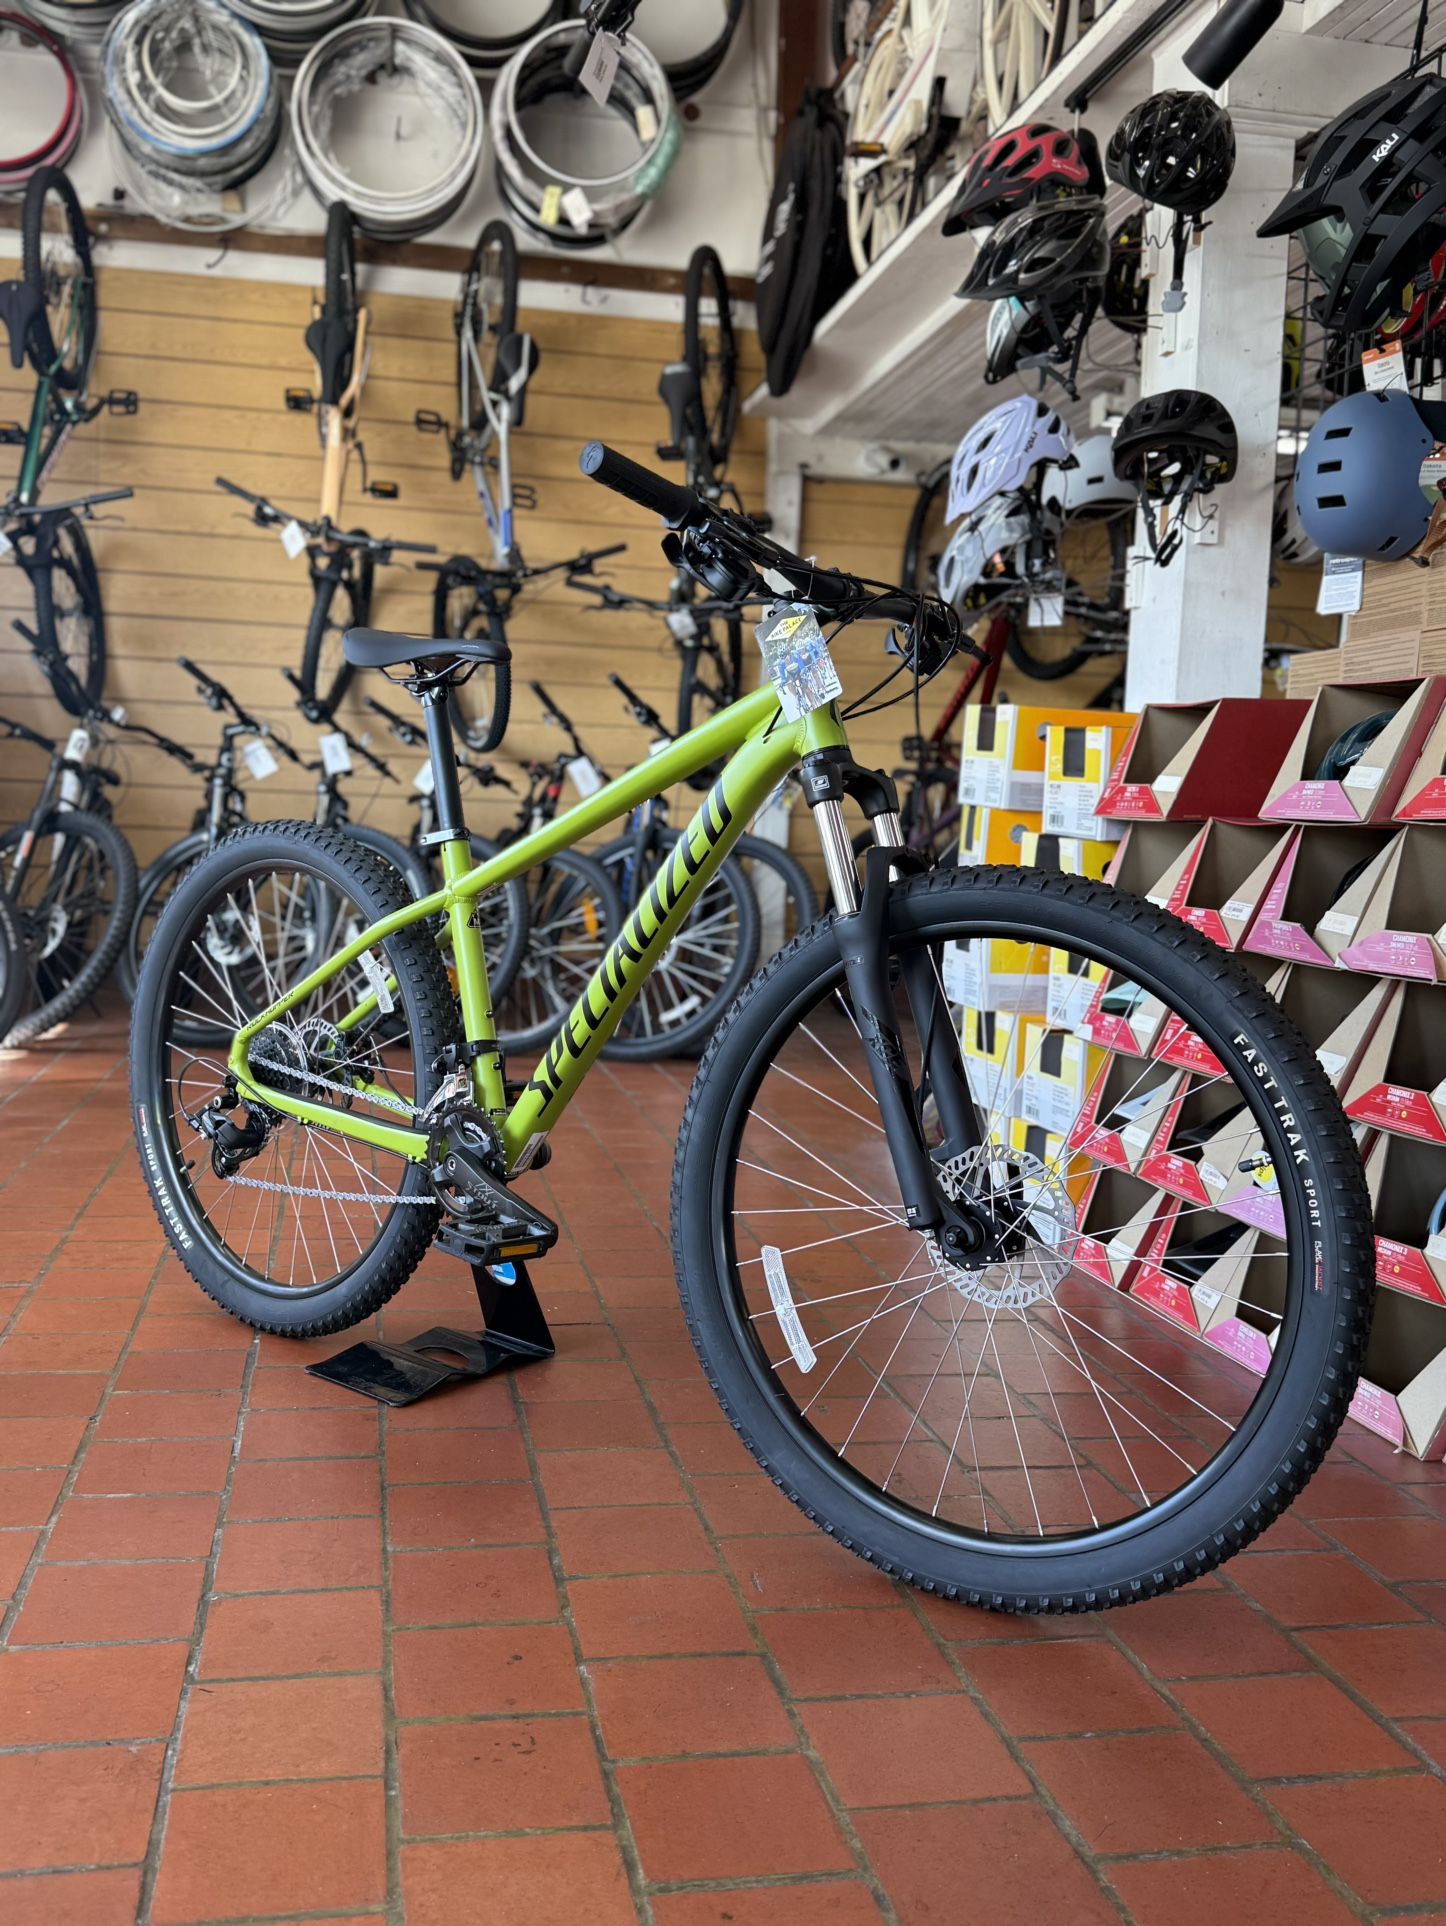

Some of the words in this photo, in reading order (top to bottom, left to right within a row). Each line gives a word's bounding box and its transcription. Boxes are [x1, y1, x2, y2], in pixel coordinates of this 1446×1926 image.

[1371, 132, 1400, 162] KALI
[528, 774, 733, 1119] SPECIALIZED
[1233, 1033, 1277, 1091] FAST
[1273, 1096, 1311, 1165] TRAK
[1303, 1178, 1322, 1228] SPORT
[145, 1143, 157, 1172] SPORT
[153, 1176, 174, 1216] TRAK
[169, 1216, 193, 1250] FAST
